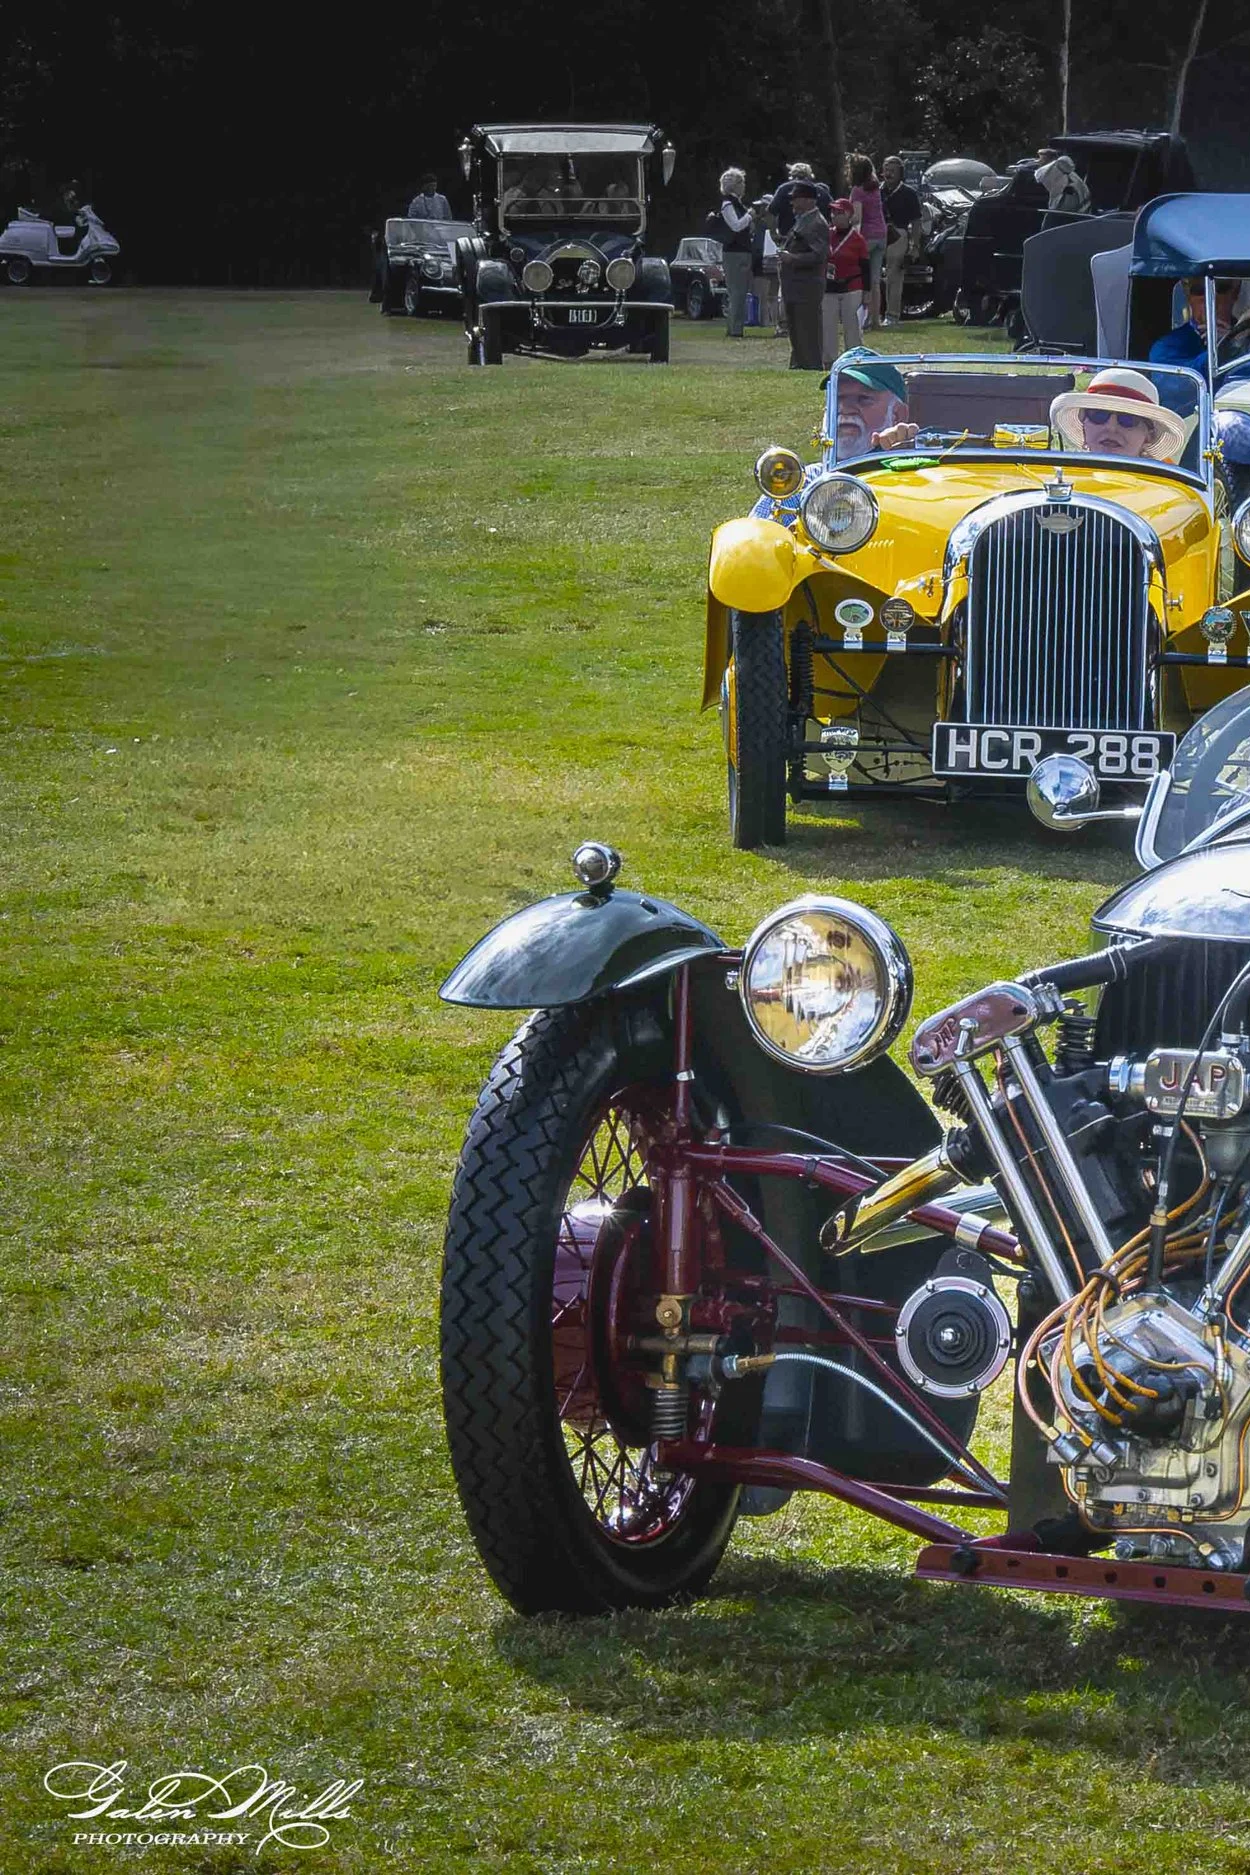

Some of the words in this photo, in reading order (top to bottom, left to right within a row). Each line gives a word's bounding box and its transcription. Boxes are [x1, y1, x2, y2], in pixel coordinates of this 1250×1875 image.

[947, 728, 1043, 771] HCR
[1066, 733, 1161, 776] 288
[1158, 1060, 1228, 1095] JAP
